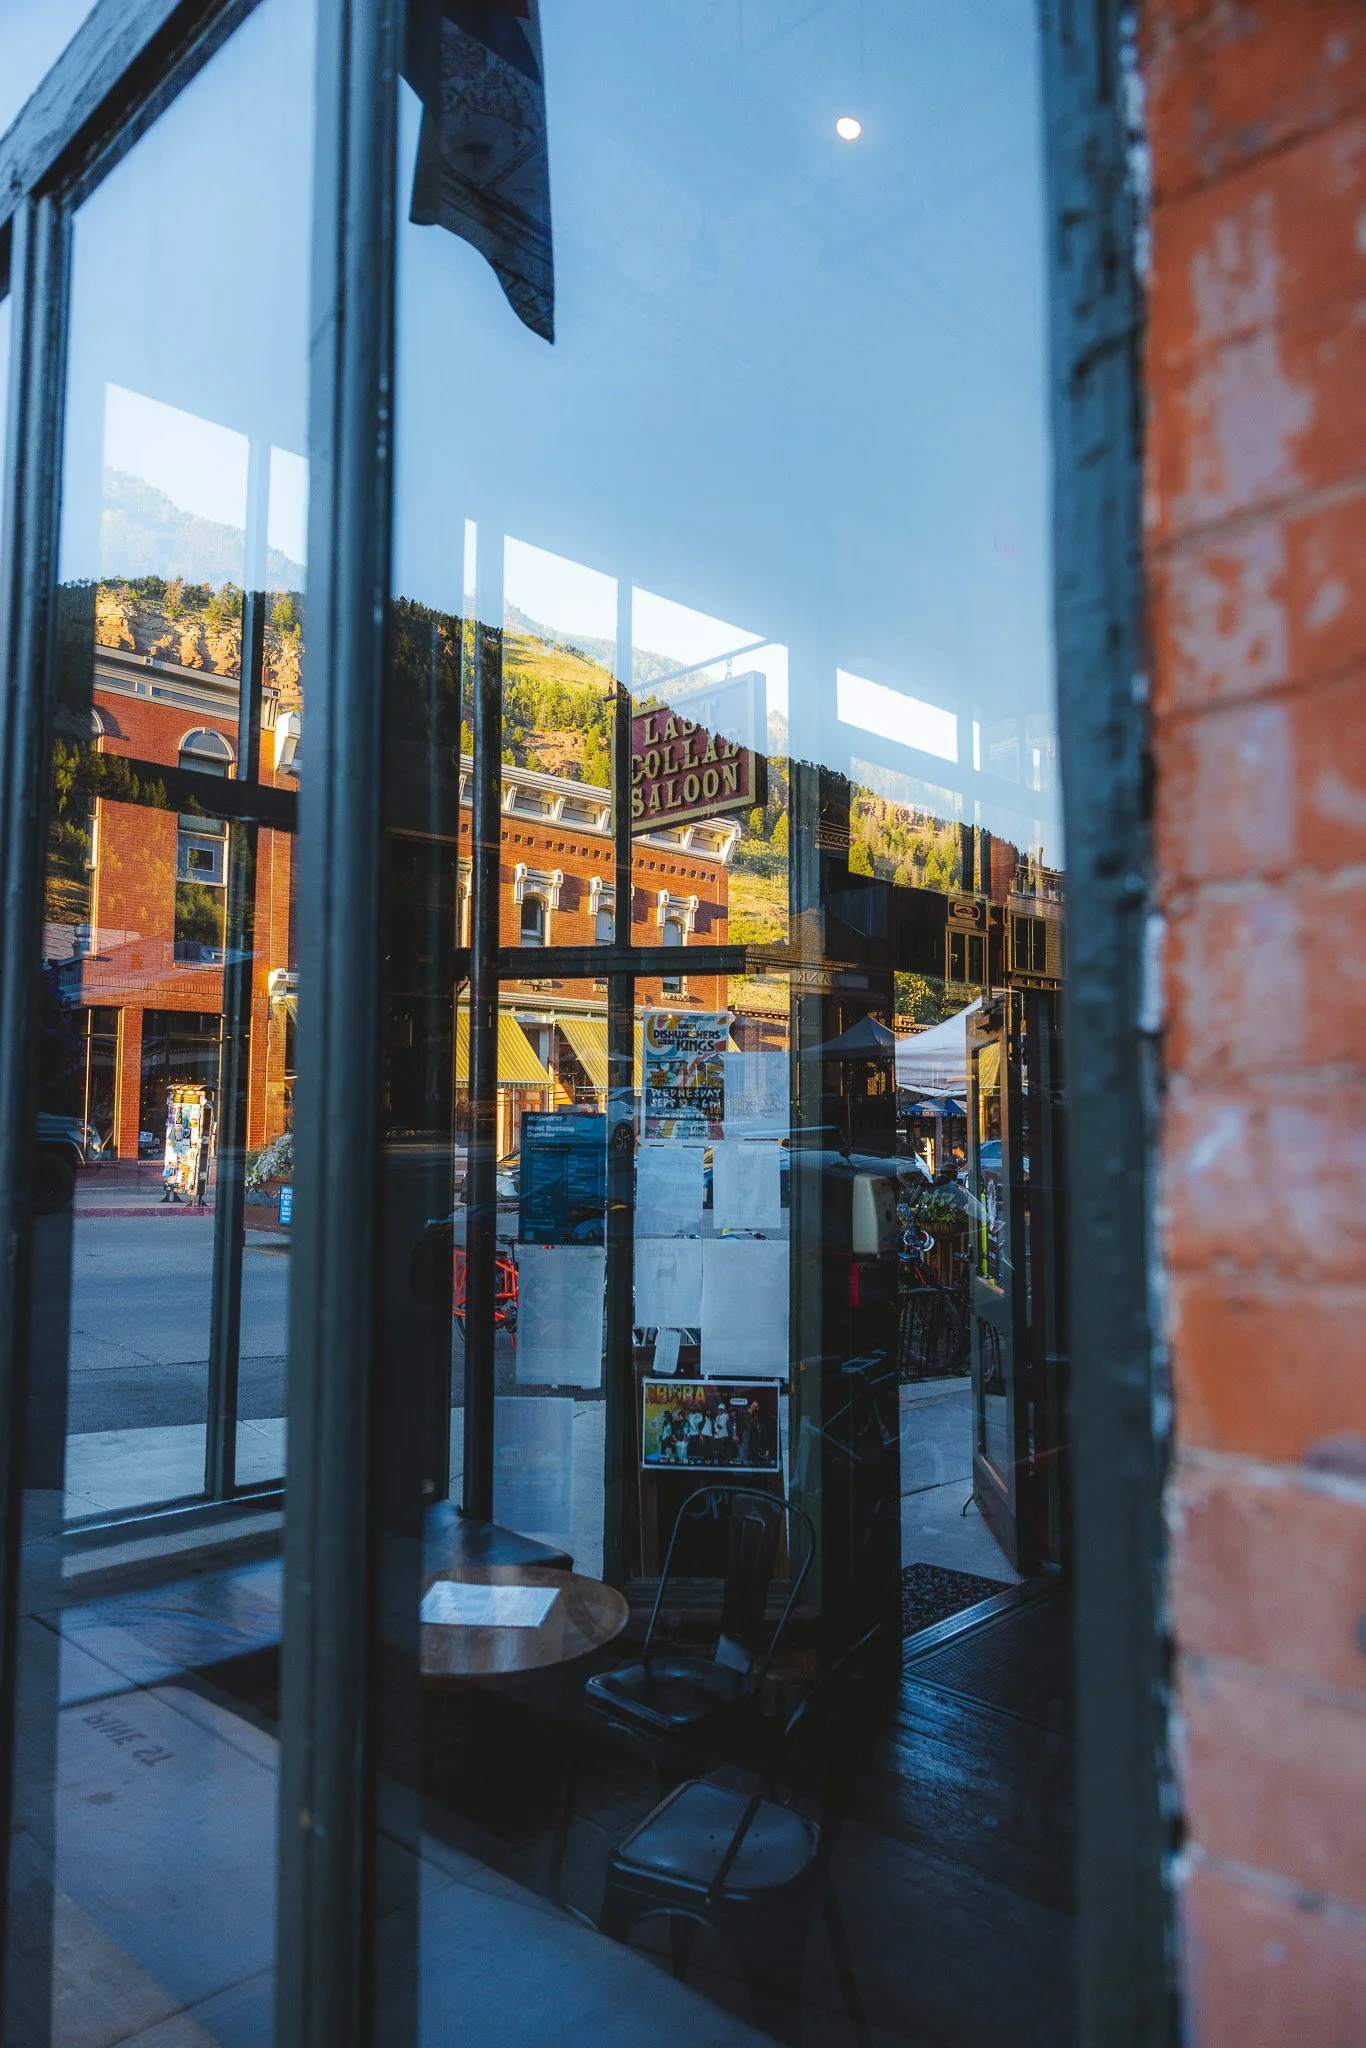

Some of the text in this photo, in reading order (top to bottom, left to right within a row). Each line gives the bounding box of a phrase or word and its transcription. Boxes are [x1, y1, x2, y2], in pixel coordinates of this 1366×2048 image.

[631, 762, 739, 818] SALOON
[653, 1029, 721, 1040] DISHWAHERS
[676, 1039, 716, 1052] KINGS
[651, 1088, 722, 1098] WEDNESDAY
[650, 1097, 675, 1108] SEPT
[526, 1124, 545, 1132] Meet
